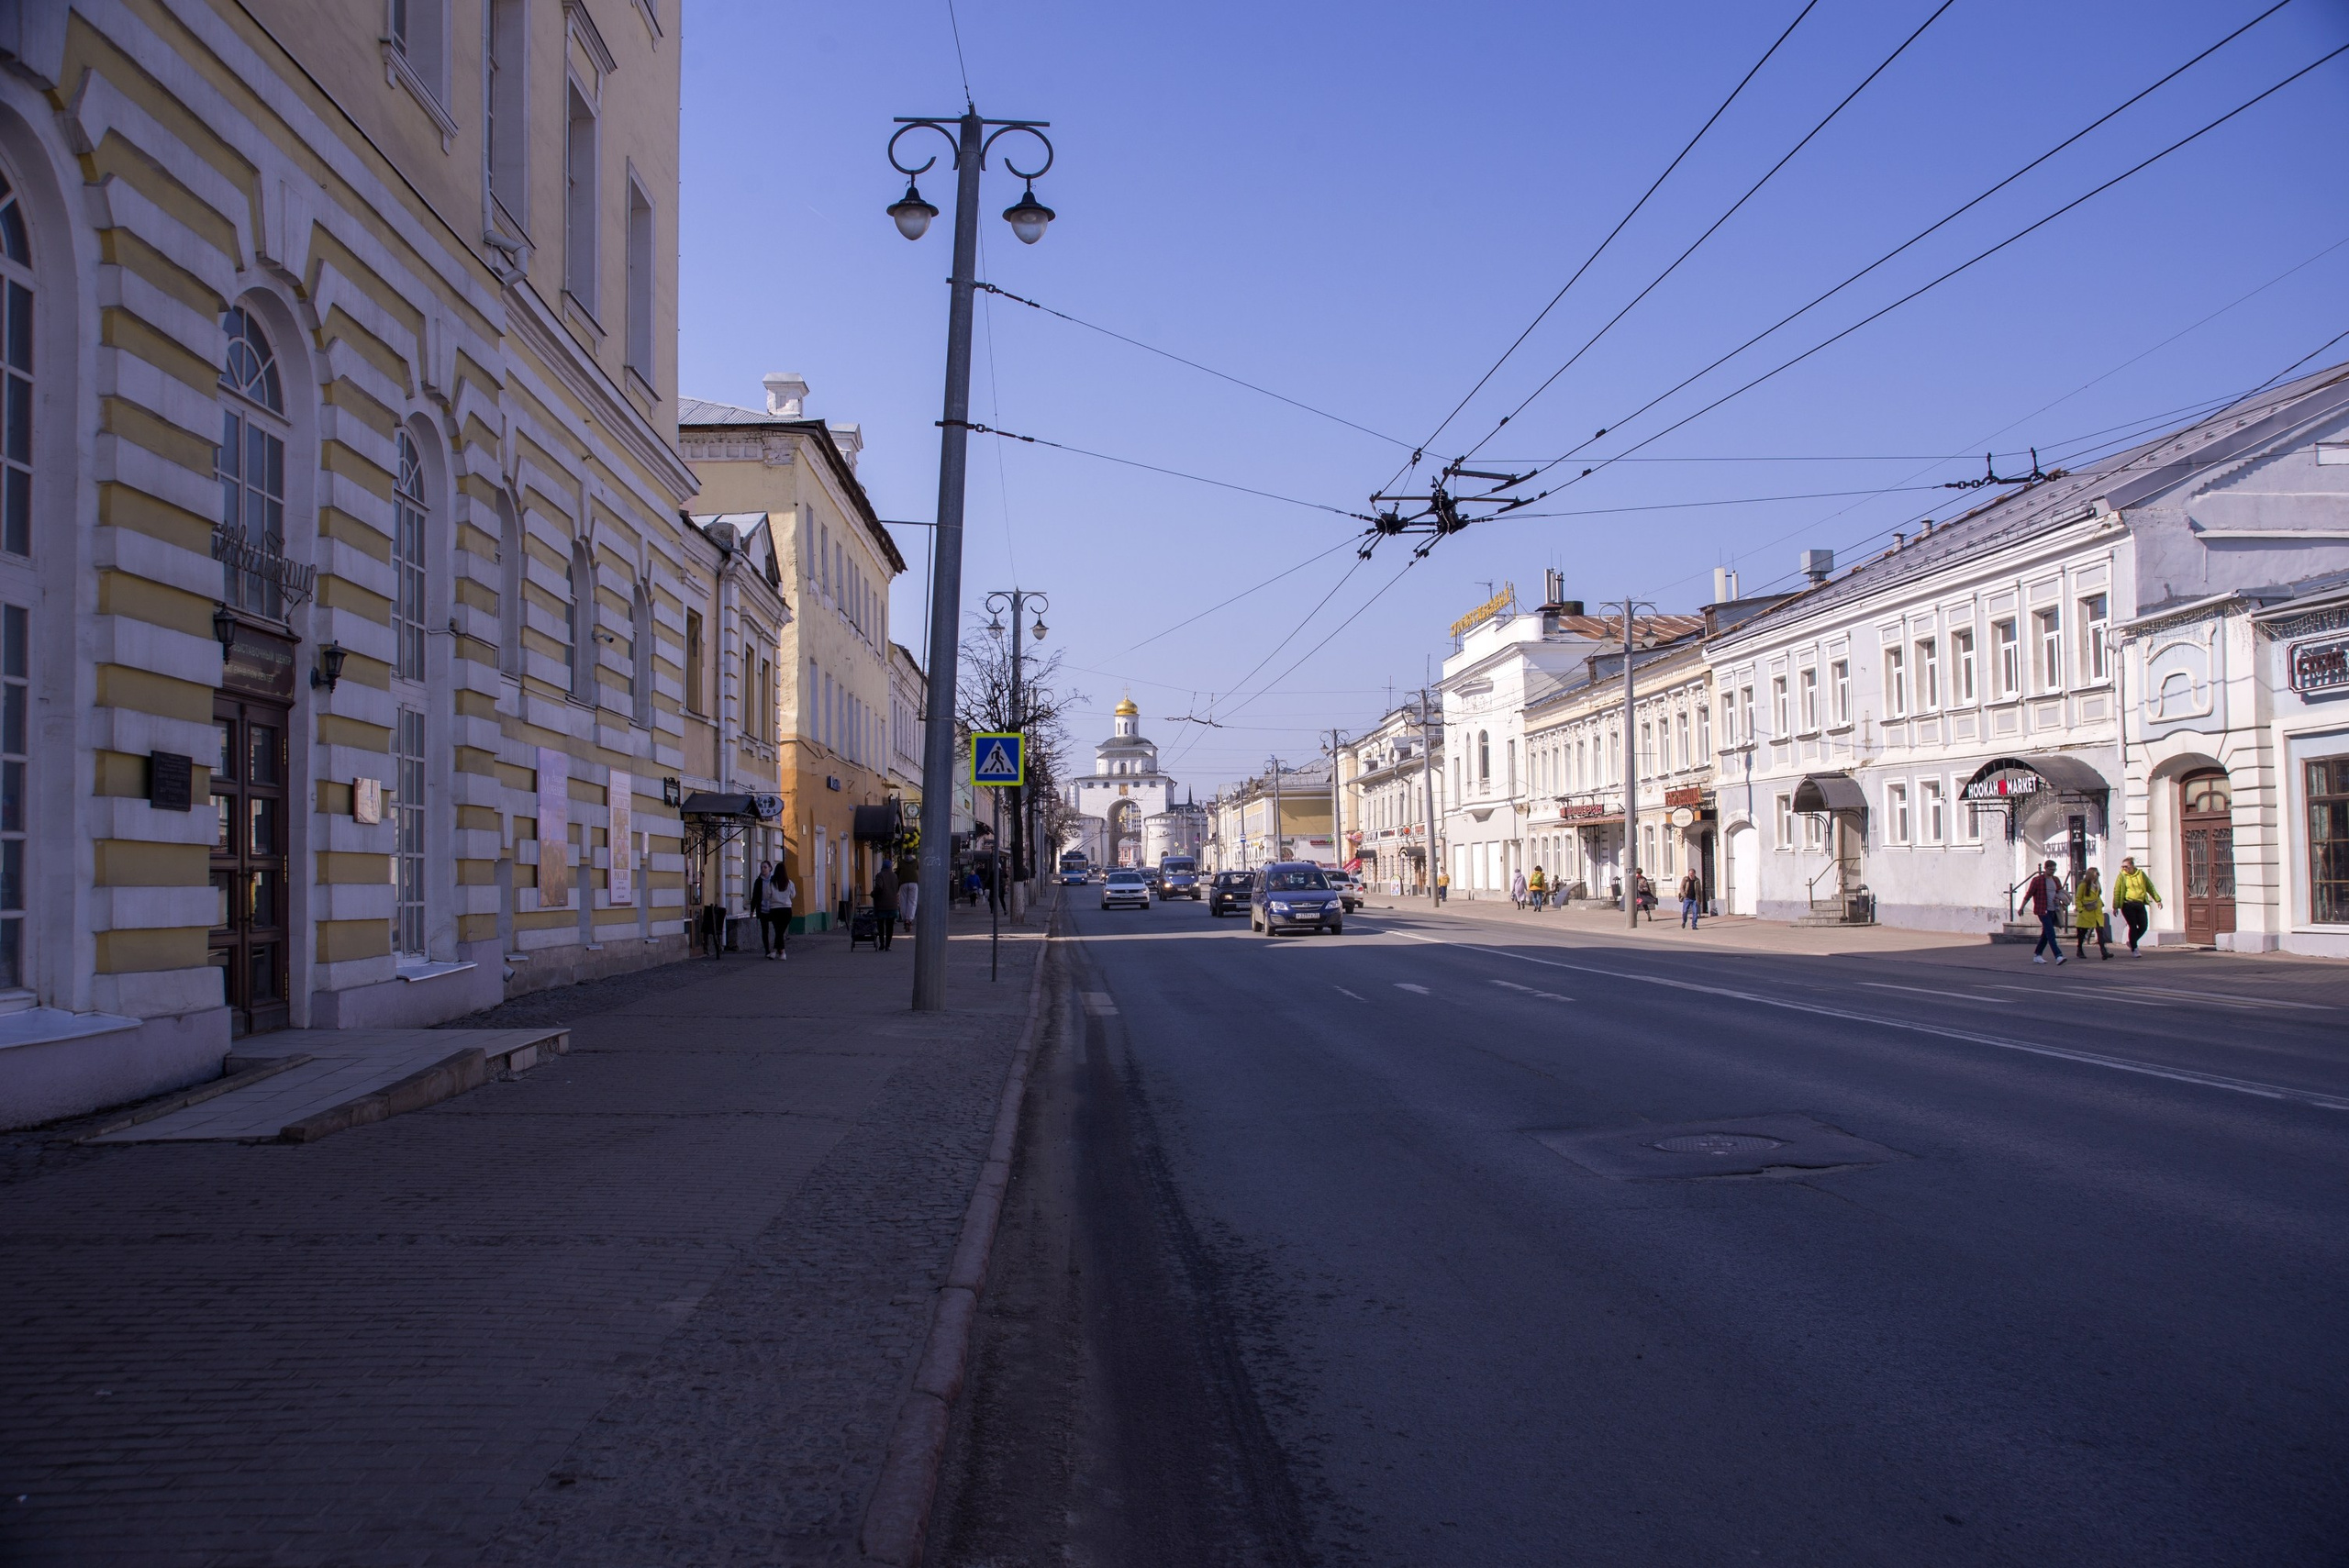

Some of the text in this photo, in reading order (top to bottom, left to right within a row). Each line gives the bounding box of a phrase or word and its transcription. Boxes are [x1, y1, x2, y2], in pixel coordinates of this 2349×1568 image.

[276, 652, 292, 665] ЦЕНТР
[1968, 777, 2036, 798] HOOKAH MARKET
